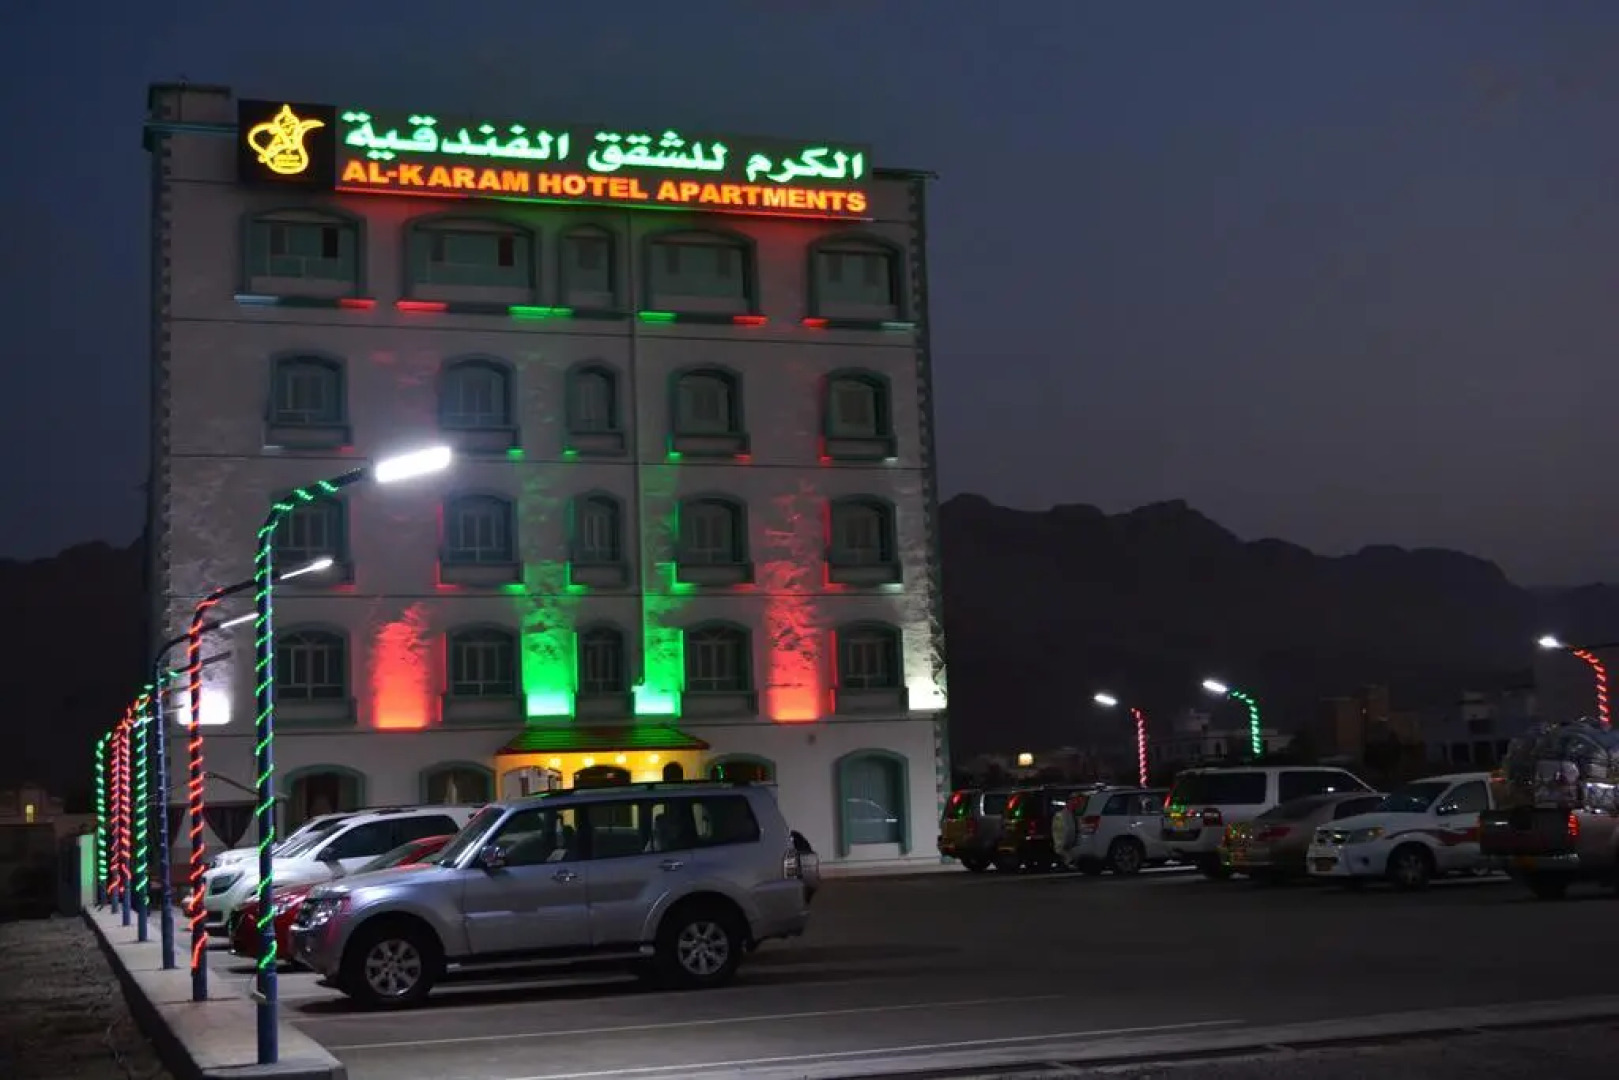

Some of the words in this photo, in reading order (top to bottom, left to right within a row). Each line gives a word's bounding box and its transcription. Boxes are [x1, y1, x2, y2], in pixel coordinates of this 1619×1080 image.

[341, 111, 570, 161] الفندقية
[587, 129, 728, 172] للشقق
[341, 160, 530, 192] AL-KARAM
[537, 173, 648, 199] HOTEL
[656, 180, 867, 212] APARTMENTS
[745, 146, 863, 182] الكرم
